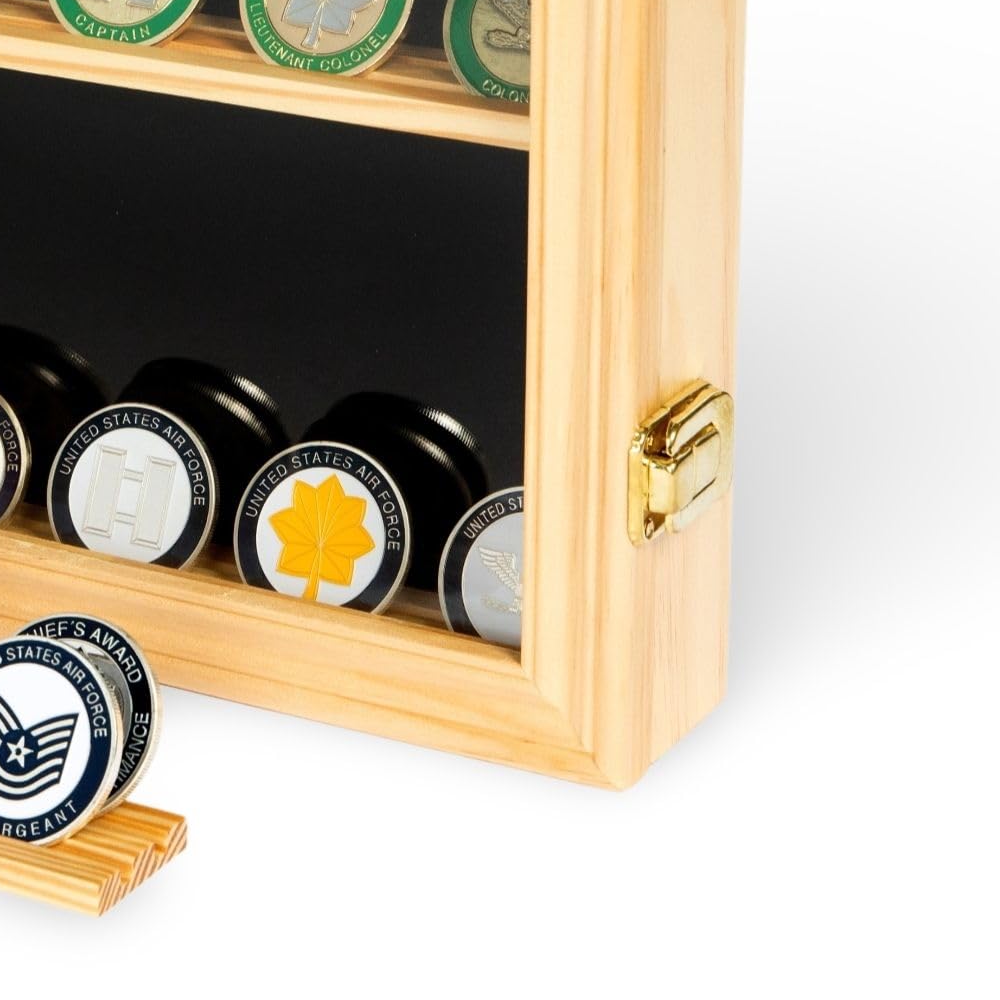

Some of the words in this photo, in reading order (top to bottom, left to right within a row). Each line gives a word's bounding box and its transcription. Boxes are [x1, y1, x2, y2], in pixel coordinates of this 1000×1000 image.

[75, 14, 150, 42] CAPTAIN
[250, 3, 314, 71] LIEUTENANT
[320, 32, 387, 71] COLONEL
[482, 79, 529, 103] COLON
[0, 420, 18, 472] FORCE
[59, 424, 99, 476] UNITED
[103, 412, 160, 430] STATES
[163, 426, 186, 448] AIR
[183, 449, 205, 506] FORCE
[246, 464, 287, 518] UNITED
[291, 452, 353, 470] STATES
[355, 466, 380, 490] AIR
[378, 491, 400, 550] FORCE
[464, 503, 505, 539] UNITED
[90, 629, 143, 684] AWARD
[6, 646, 61, 666] STATES
[62, 661, 86, 683] AIR
[83, 682, 107, 738] FORCE
